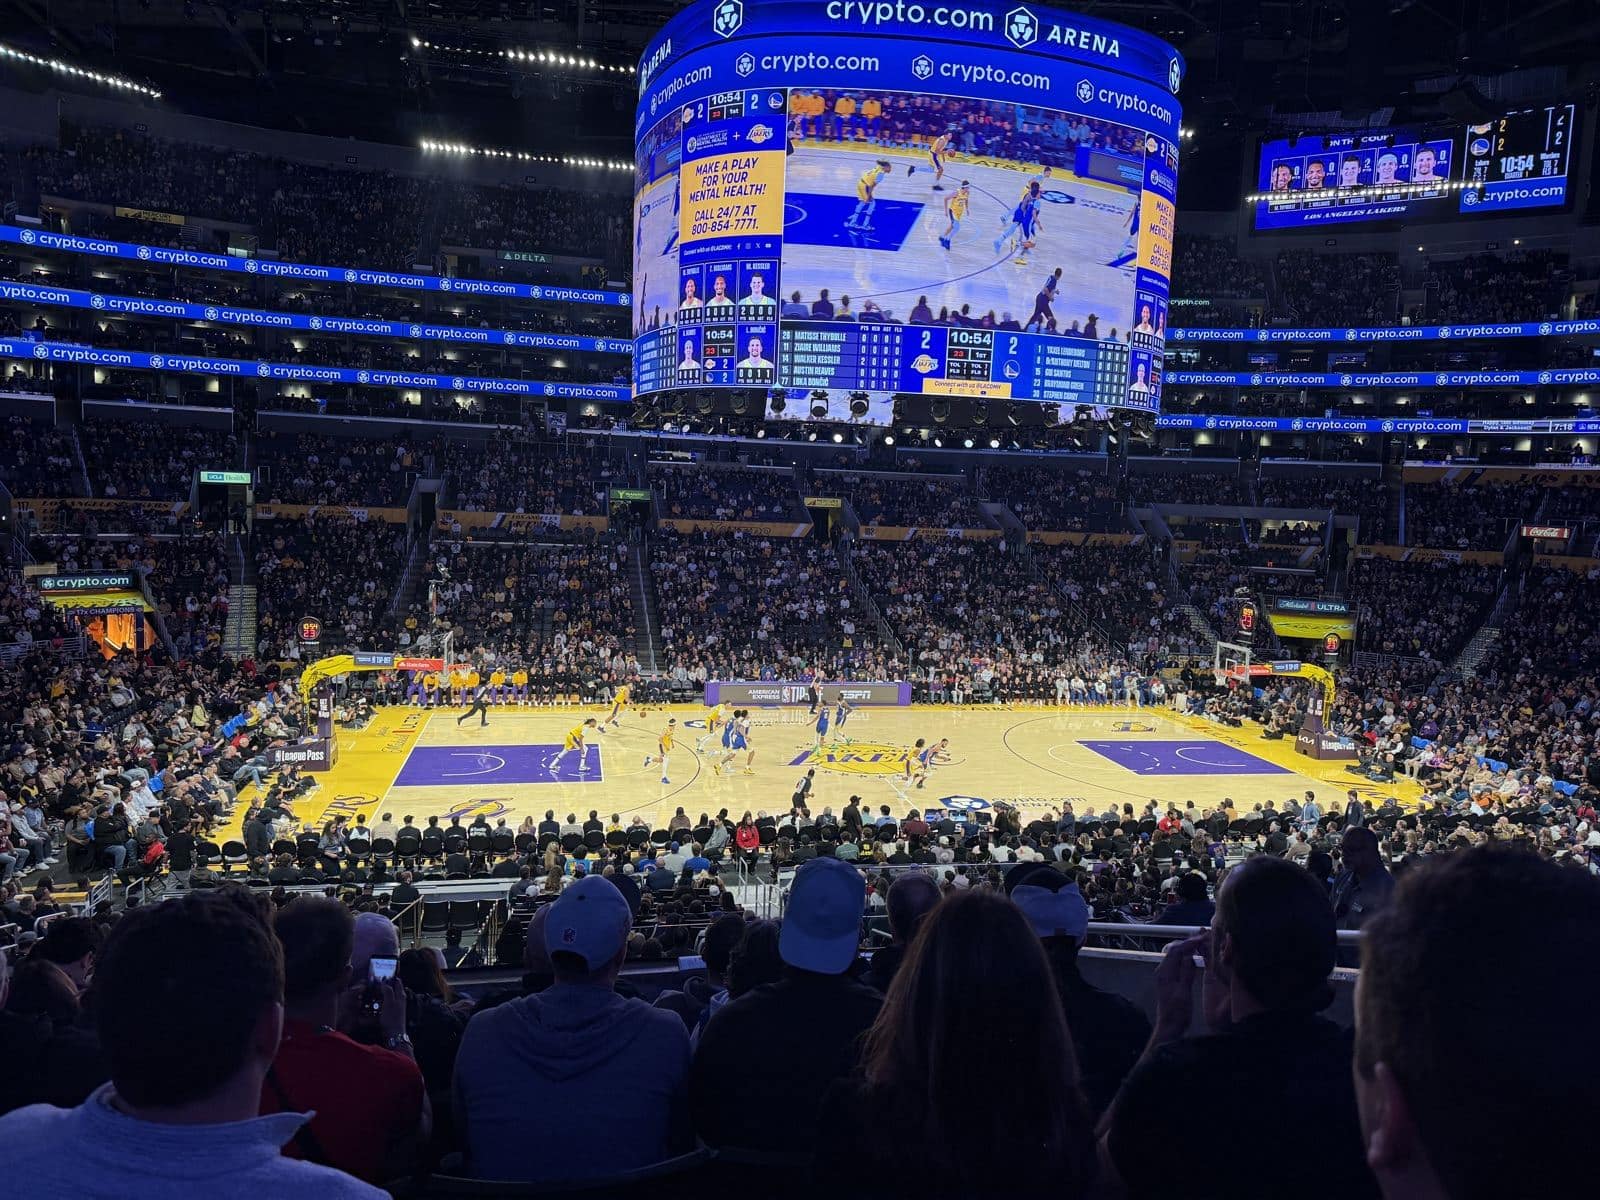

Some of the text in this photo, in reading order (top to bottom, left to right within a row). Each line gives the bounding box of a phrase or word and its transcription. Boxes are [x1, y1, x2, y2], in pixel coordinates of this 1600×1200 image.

[827, 0, 1120, 58] crypto.com ARENA
[647, 38, 672, 79] ARENA
[761, 52, 879, 72] crypto.com
[939, 60, 1050, 91] crypto.com
[658, 64, 712, 105] crypto.com
[711, 92, 741, 105] 10:54
[1098, 87, 1172, 126] crypto.com
[1497, 138, 1505, 150] 2
[1555, 131, 1562, 145] 2
[695, 157, 759, 176] MAKE A PLAY
[1500, 154, 1534, 173] 10:54
[701, 171, 749, 188] FOR YOUR
[689, 184, 767, 204] MENTAL HEALTH!
[1483, 186, 1562, 201] crypto.com
[694, 204, 757, 222] CALL 24/7 AT
[1323, 209, 1366, 219] ANGELES
[1367, 205, 1408, 215] LAKERS
[40, 233, 118, 254] crypto.com
[155, 250, 228, 268] crypto.com
[514, 253, 546, 263] DELTA
[261, 262, 329, 278] crypto.com
[360, 271, 424, 288] crypto.com
[454, 279, 516, 294] crypto.com
[0, 285, 70, 303] ypto.com
[544, 288, 604, 302] crypto.com
[109, 298, 185, 315] crypto.com
[222, 309, 292, 326] crypto.com
[326, 318, 392, 333] crypto.com
[1454, 326, 1522, 337] crypto.com
[1555, 322, 1600, 334] crypto.
[424, 327, 488, 341] crypto.com
[518, 334, 580, 348] crypto.com
[705, 330, 733, 340] 10:54
[920, 330, 931, 349] 2
[950, 331, 992, 345] 10:54
[1187, 329, 1244, 340] crypto.com
[1271, 329, 1331, 340] crypto.com
[1360, 329, 1423, 341] crypto.com
[705, 347, 715, 355] 23
[1008, 336, 1018, 355] 2
[53, 347, 131, 364] crypto.com
[860, 357, 866, 366] 2
[168, 357, 240, 373] crypto.com
[722, 358, 728, 369] 2
[273, 365, 341, 380] crypto.com
[722, 372, 728, 383] 2
[1179, 373, 1236, 385] crypto.com
[1451, 373, 1520, 385] crypto.com
[1555, 371, 1600, 383] crypto.
[373, 373, 437, 387] crypto.com
[467, 379, 529, 393] crypto.com
[882, 381, 887, 389] 1
[894, 381, 898, 390] 1
[1264, 374, 1325, 386] crypto.com
[1355, 374, 1418, 386] crypto.com
[558, 386, 618, 398] crypto.com
[1219, 418, 1277, 429] crypto.com
[1306, 419, 1367, 430] crypto.com
[1396, 420, 1462, 432] crypto.com
[1529, 527, 1559, 538] Coca-Cola
[56, 576, 129, 588] crypto.com
[89, 607, 135, 615] CHAMPIONS
[1316, 604, 1346, 612] ULTRA
[840, 690, 872, 700] ESPN
[281, 749, 325, 762] League Pass
